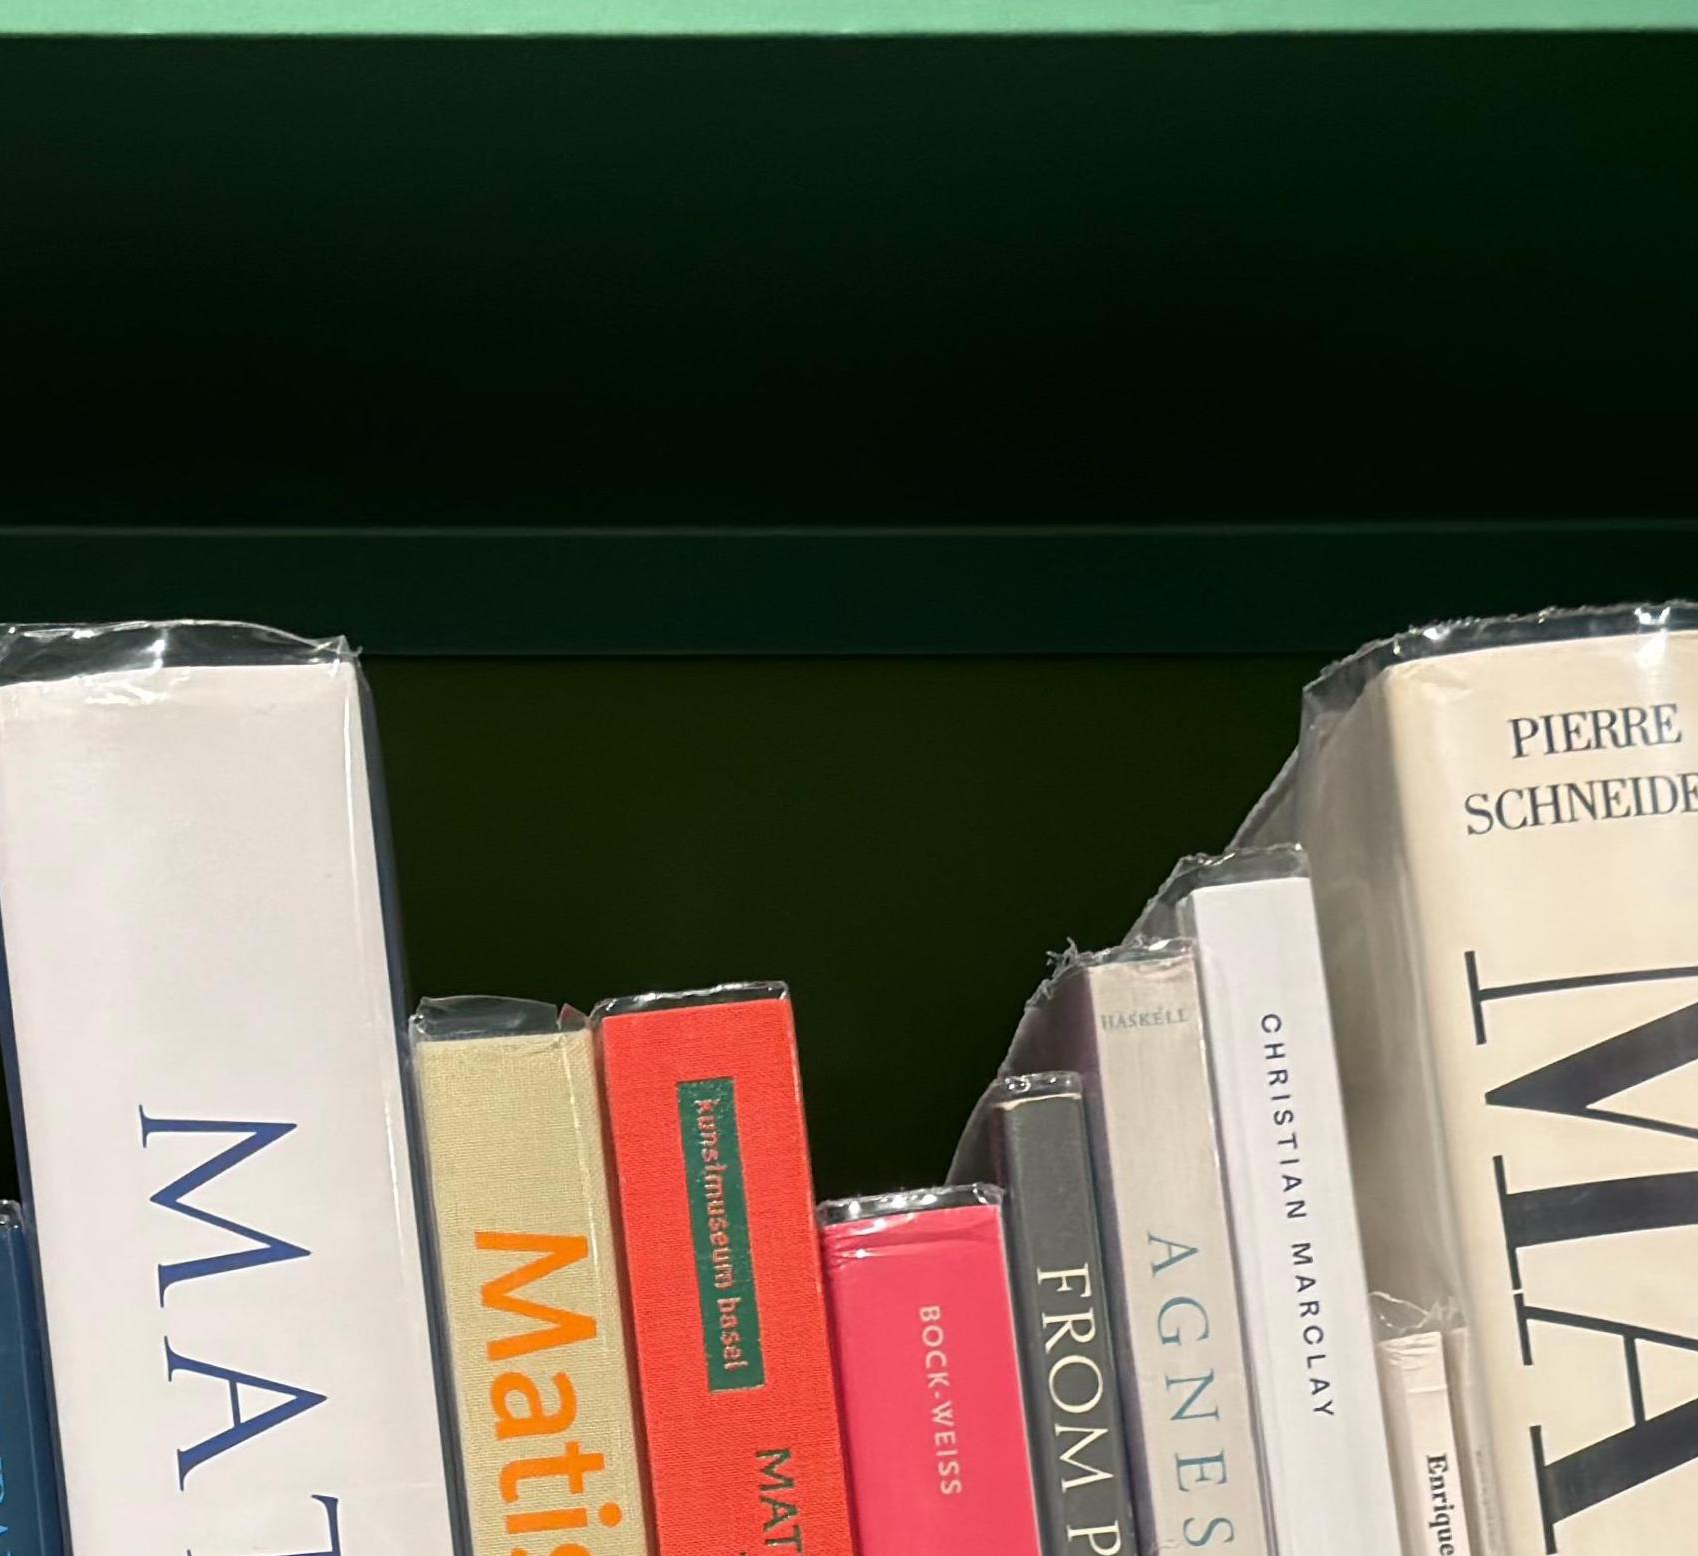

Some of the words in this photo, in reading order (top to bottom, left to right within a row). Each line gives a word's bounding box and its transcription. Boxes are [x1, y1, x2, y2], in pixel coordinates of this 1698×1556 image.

[1506, 700, 1684, 759] PIERRE
[1100, 1007, 1190, 1031] HASKELL
[694, 1097, 736, 1290] kunstmuseum
[717, 1296, 749, 1371] basel
[1260, 1011, 1308, 1220] CHRISTIAN
[1290, 1241, 1336, 1418] MARCLAY
[918, 1303, 963, 1497] BOCK-WEISS
[1036, 1261, 1115, 1494] FROM
[1146, 1230, 1235, 1548] AGNES
